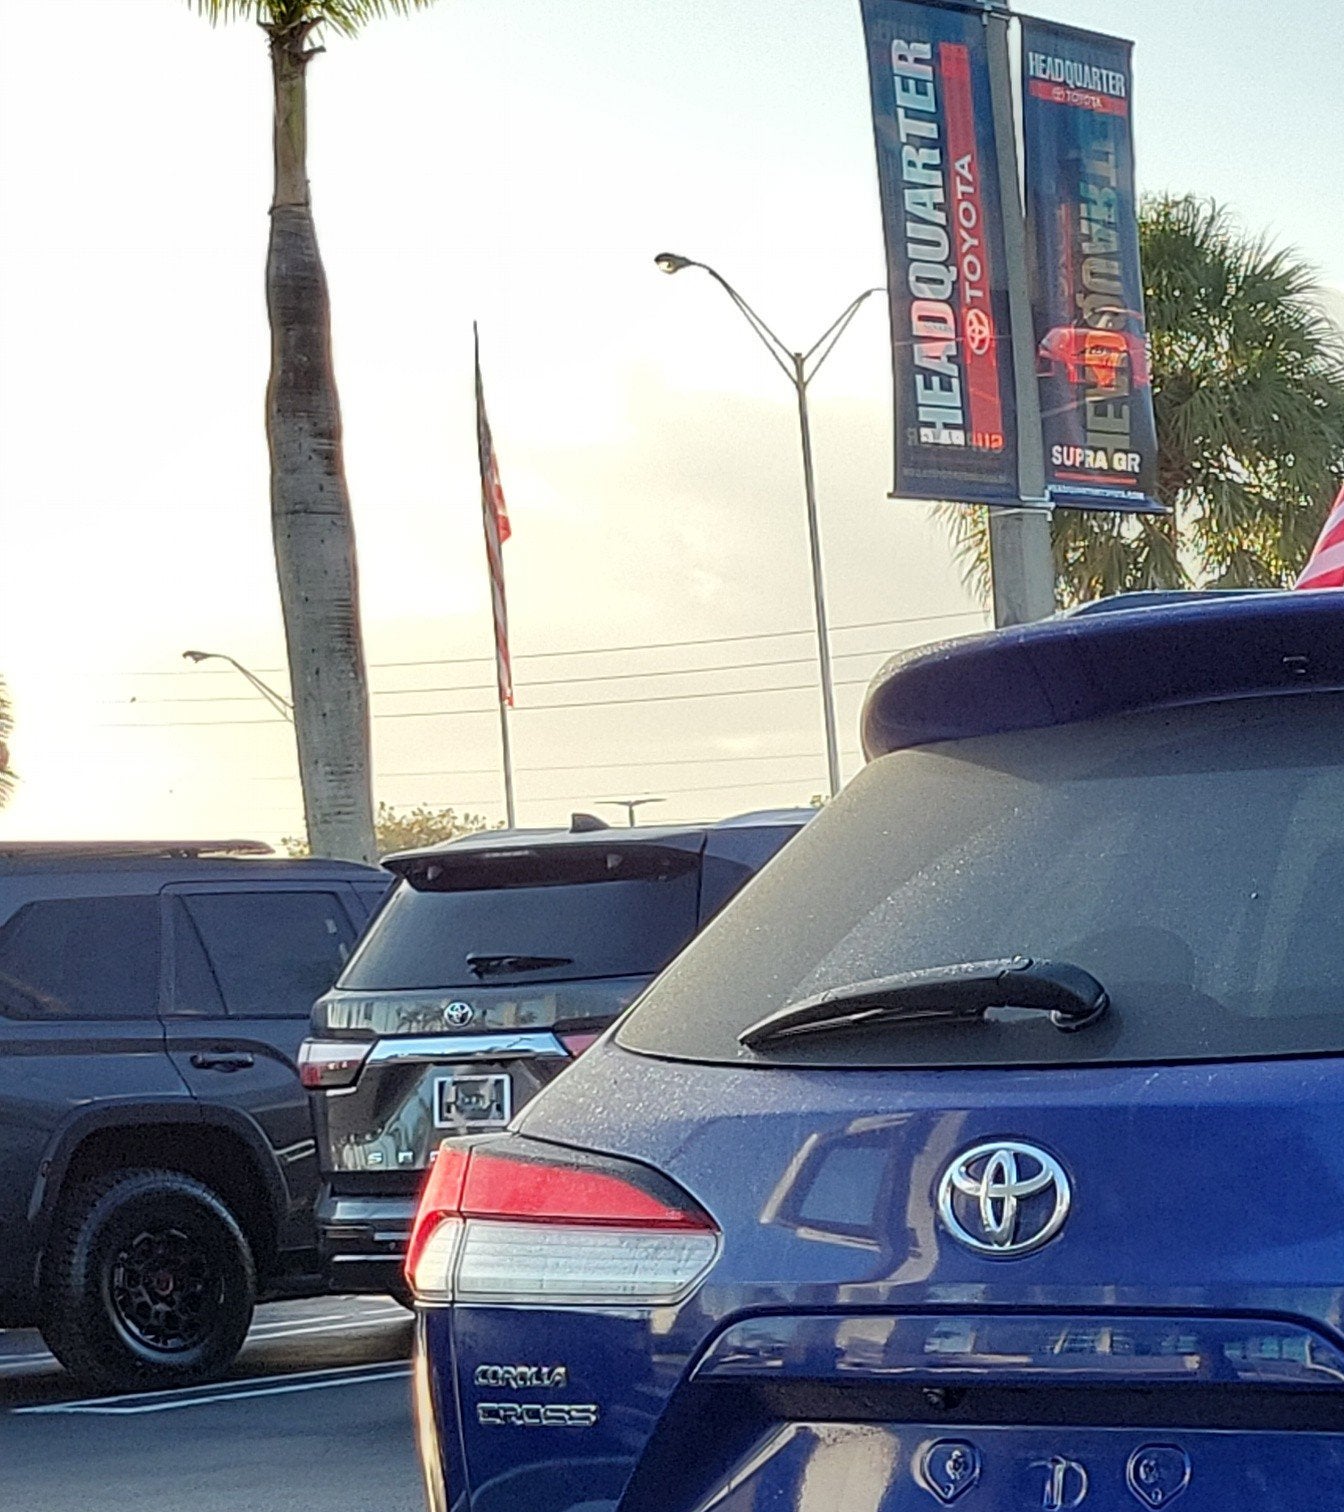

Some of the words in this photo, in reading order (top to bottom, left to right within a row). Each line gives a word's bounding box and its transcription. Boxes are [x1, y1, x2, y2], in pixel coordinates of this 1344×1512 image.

[1028, 51, 1126, 98] HEADQUARTER
[1065, 89, 1103, 109] TOYOTA
[891, 39, 965, 446] HEADQUARTER
[954, 153, 984, 304] TOYOTA
[1051, 444, 1109, 471] SUPRA
[1112, 451, 1141, 473] GR
[475, 1364, 567, 1389] COROLLA
[477, 1402, 598, 1427] CROSS
